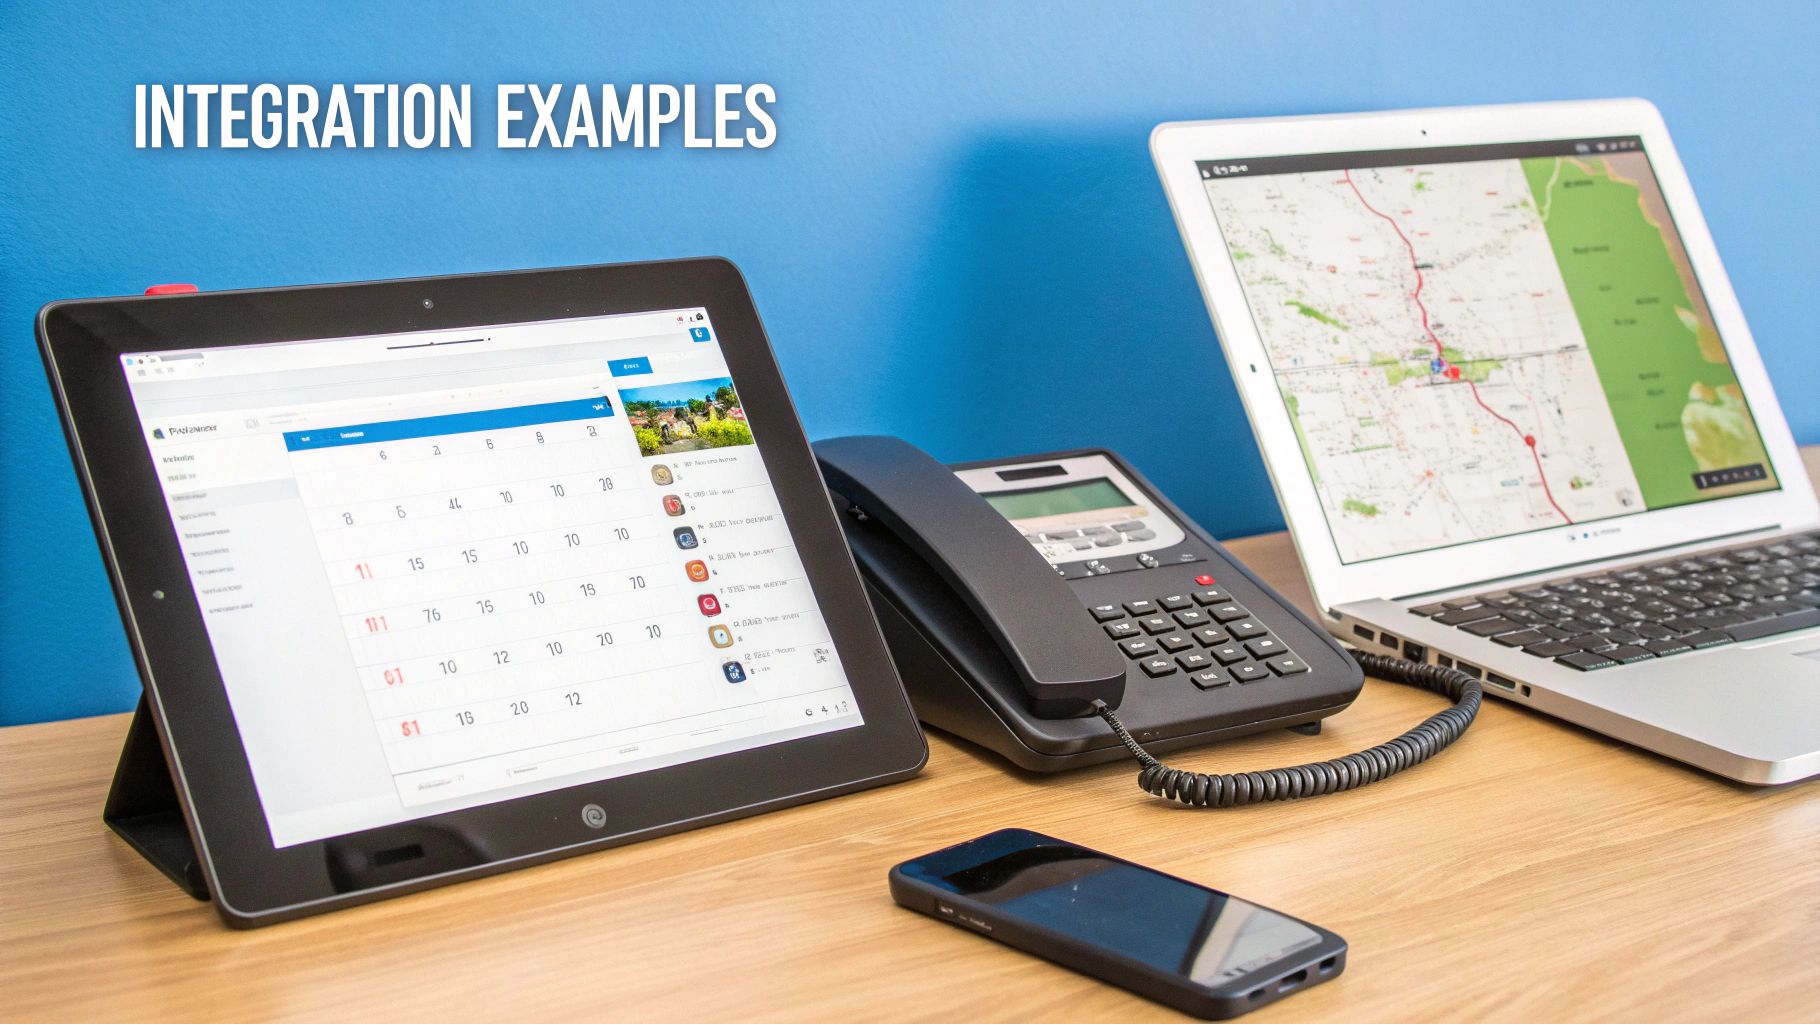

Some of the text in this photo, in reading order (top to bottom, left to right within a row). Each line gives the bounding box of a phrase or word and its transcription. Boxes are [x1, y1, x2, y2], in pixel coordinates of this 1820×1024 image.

[407, 557, 425, 571] 15
[461, 549, 478, 564] 15
[512, 541, 529, 555] 10
[564, 533, 581, 548] 10
[614, 527, 630, 541] 10
[528, 591, 546, 605] 10
[438, 659, 458, 675] 10
[492, 650, 511, 665] 12
[545, 641, 563, 657] 10
[564, 691, 583, 707] 12
